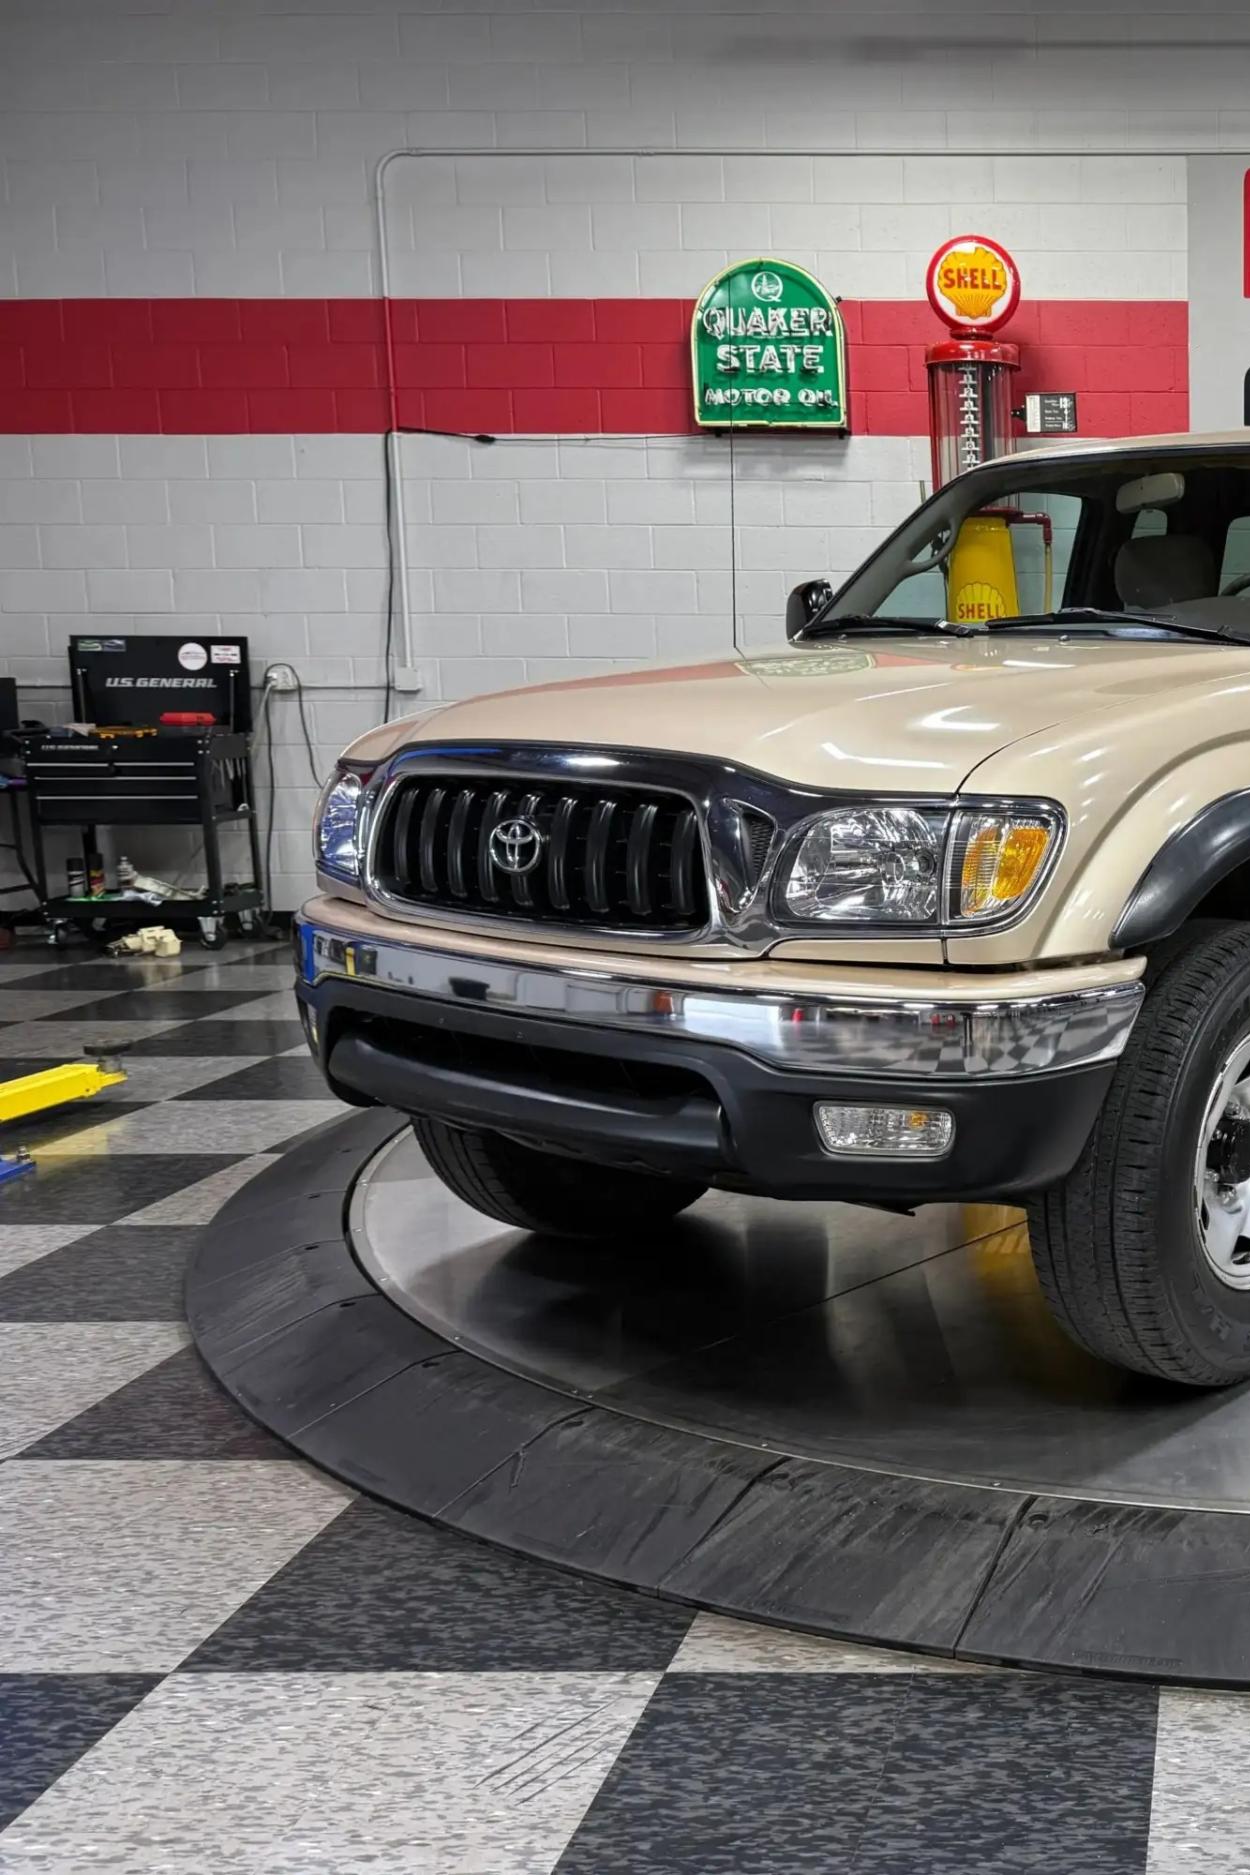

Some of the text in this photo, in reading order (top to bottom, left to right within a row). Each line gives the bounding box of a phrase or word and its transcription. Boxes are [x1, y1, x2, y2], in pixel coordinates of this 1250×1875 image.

[943, 268, 1002, 290] SHELL
[702, 306, 834, 341] QUAKER
[716, 344, 825, 374] STATE
[704, 388, 839, 407] MOTOR OIL
[957, 603, 1004, 620] SHELL
[135, 677, 218, 688] GENERAL
